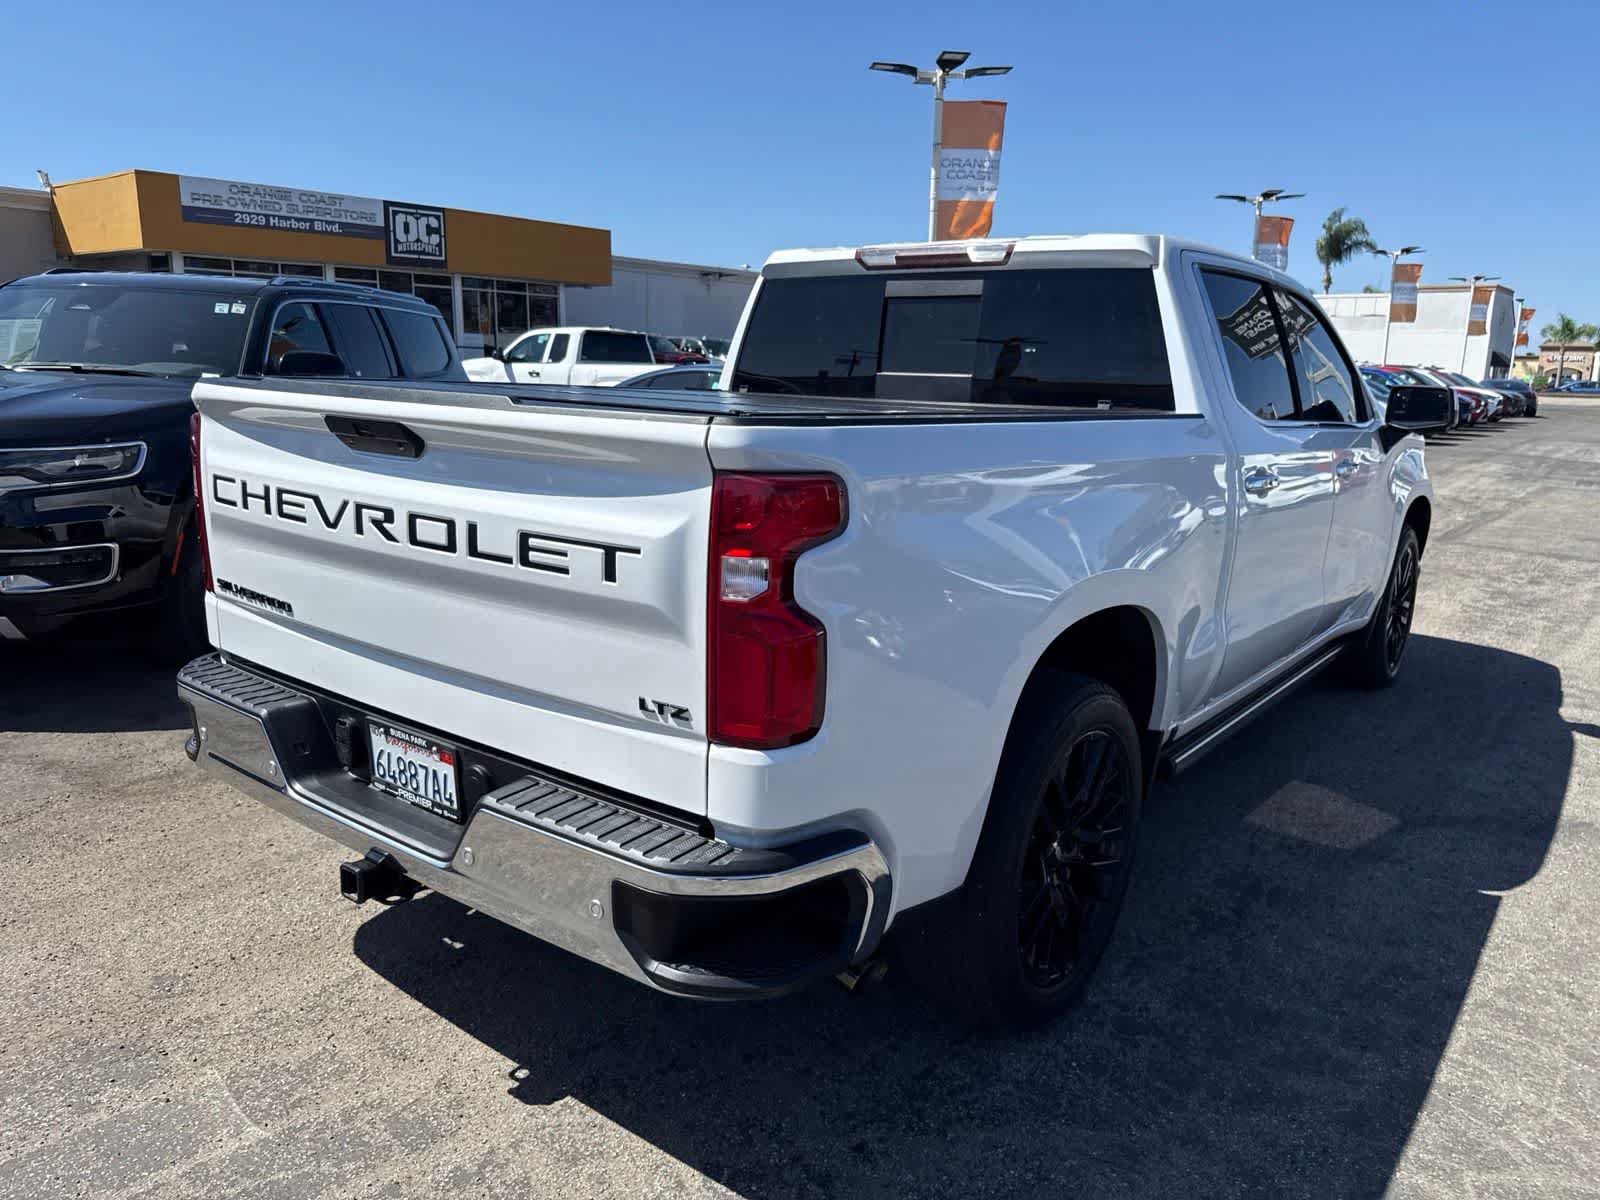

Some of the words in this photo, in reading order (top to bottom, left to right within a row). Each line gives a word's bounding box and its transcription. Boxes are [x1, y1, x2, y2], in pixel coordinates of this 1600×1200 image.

[946, 169, 992, 181] COAST
[228, 184, 292, 201] ORANGE
[298, 192, 344, 207] COAST
[190, 192, 282, 212] PRE-OWNED
[286, 203, 377, 223] SUPERSTORE
[234, 212, 266, 226] 2929
[269, 216, 310, 231] Harbor
[314, 221, 343, 233] Blvd.
[395, 212, 440, 246] OC
[397, 241, 440, 256] MOTORSPORTS
[212, 473, 642, 584] CHEVROLET
[639, 696, 690, 722] LTZ
[389, 728, 410, 742] BUENA
[410, 736, 428, 748] PARK
[376, 748, 454, 807] 64887A4
[397, 788, 433, 810] PREMIER
